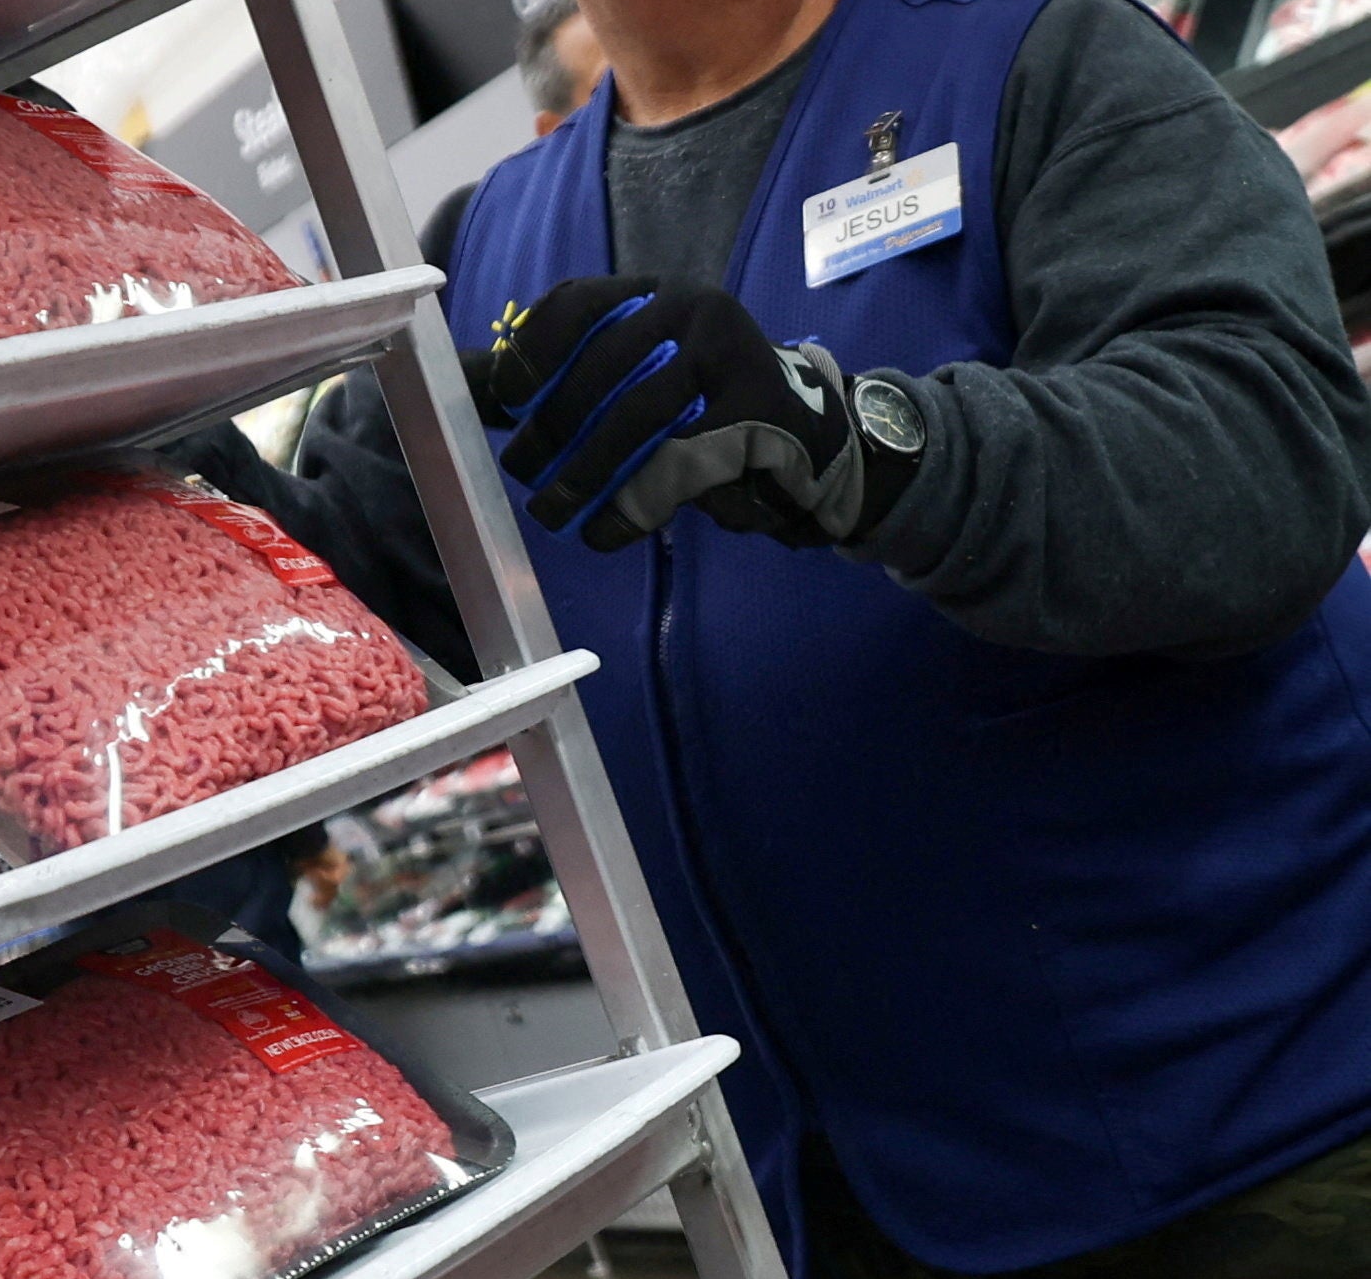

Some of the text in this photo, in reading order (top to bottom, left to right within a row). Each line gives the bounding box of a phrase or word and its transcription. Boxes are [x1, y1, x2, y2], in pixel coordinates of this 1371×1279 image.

[818, 179, 903, 214] 10 Walmart
[836, 195, 919, 242] JESUS
